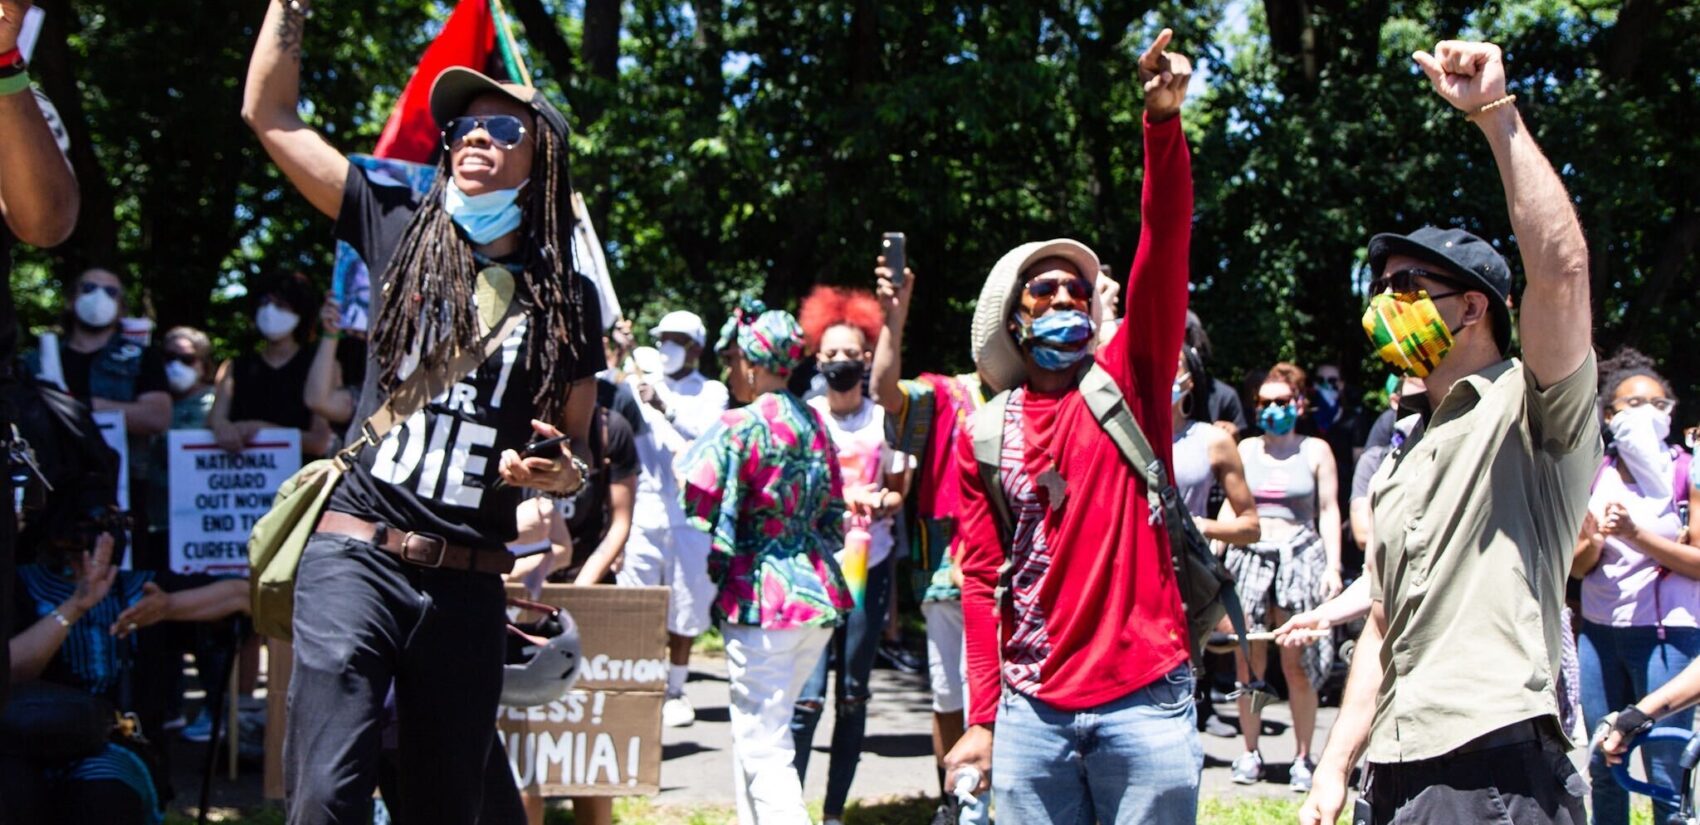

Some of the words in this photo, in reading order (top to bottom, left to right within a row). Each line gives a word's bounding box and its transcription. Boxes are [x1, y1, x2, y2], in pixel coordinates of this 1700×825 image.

[195, 453, 277, 470] NATIONAL
[370, 409, 498, 509] DIE
[208, 473, 266, 490] GUARD
[195, 494, 229, 509] OUT
[202, 515, 235, 532] END
[496, 690, 606, 724] LESS!
[498, 731, 641, 790] UMIA!
